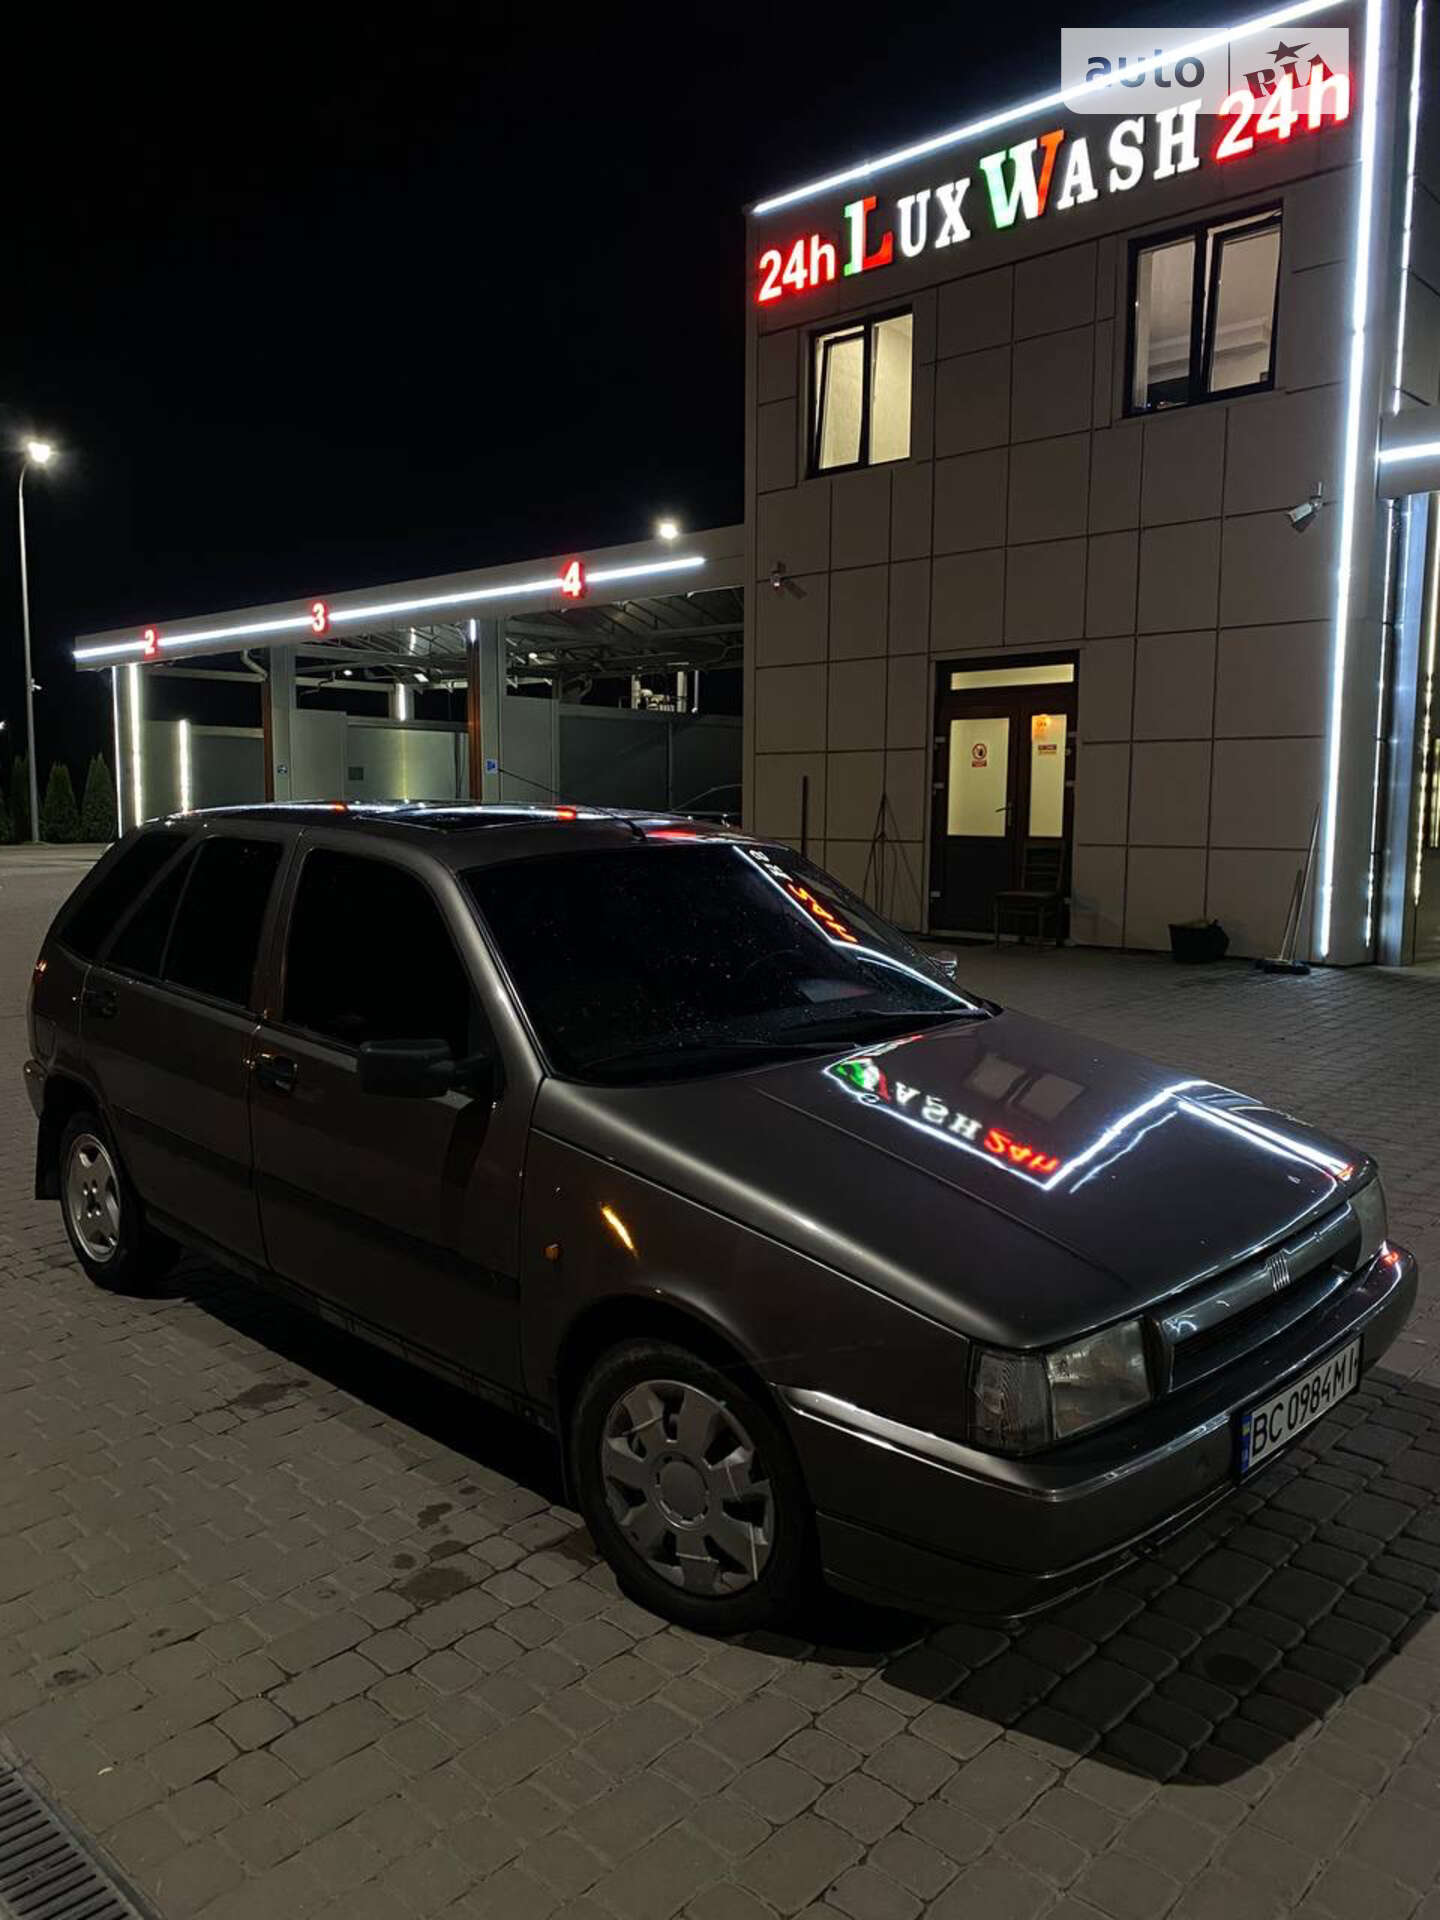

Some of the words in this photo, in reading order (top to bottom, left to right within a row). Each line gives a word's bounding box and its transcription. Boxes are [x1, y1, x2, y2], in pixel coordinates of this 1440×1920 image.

[757, 234, 836, 302] 24h
[843, 177, 972, 277] LUX
[979, 99, 1202, 229] WASH
[1215, 62, 1351, 160] 24h
[561, 561, 585, 597] 4
[311, 602, 327, 633] 3
[143, 627, 157, 656] 2
